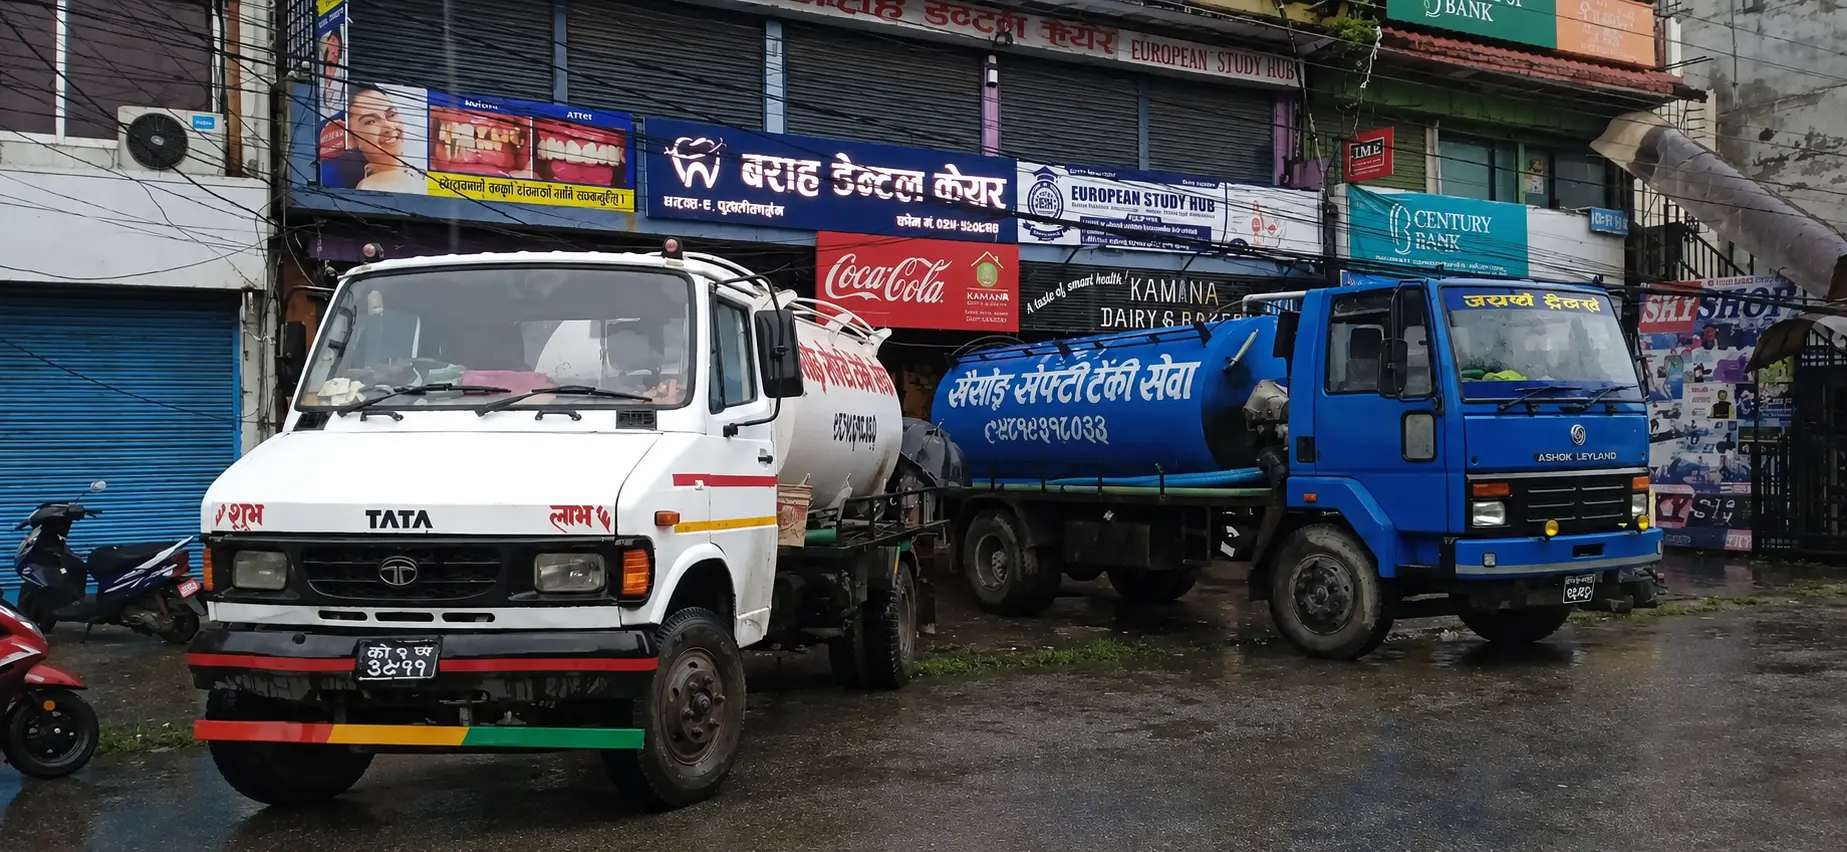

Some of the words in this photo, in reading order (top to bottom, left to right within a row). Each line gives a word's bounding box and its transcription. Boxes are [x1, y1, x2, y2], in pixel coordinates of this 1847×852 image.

[1445, 0, 1494, 21] BANK
[1131, 39, 1207, 70] EUROPEAN
[1217, 51, 1261, 75] STUDY
[1267, 56, 1294, 79] HUB
[741, 152, 822, 197] बराह
[932, 163, 1008, 209] केयर
[1071, 186, 1141, 205] EUROPEAN
[1144, 192, 1188, 210] STUDY
[1190, 195, 1215, 212] HUB
[1414, 209, 1492, 234] CENTURY
[1415, 232, 1461, 253] BANK
[825, 253, 953, 304] Coca-Cola
[1130, 277, 1219, 305] KAMANA
[966, 291, 1009, 301] KAMANA
[1027, 302, 1034, 315] A
[1034, 291, 1055, 309] taste
[1055, 281, 1067, 298] of
[1067, 273, 1094, 292] smart
[1100, 307, 1157, 329] DAIRY
[1161, 311, 1174, 328] &
[1014, 360, 1091, 404] सेफ्टी
[1140, 353, 1202, 401] सेवा
[1538, 452, 1572, 462] ASHOK
[1576, 451, 1617, 461] LEYLAND
[228, 502, 265, 532] शुभ
[365, 509, 434, 530] TATA
[549, 504, 595, 534] लाभ
[367, 643, 392, 658] को
